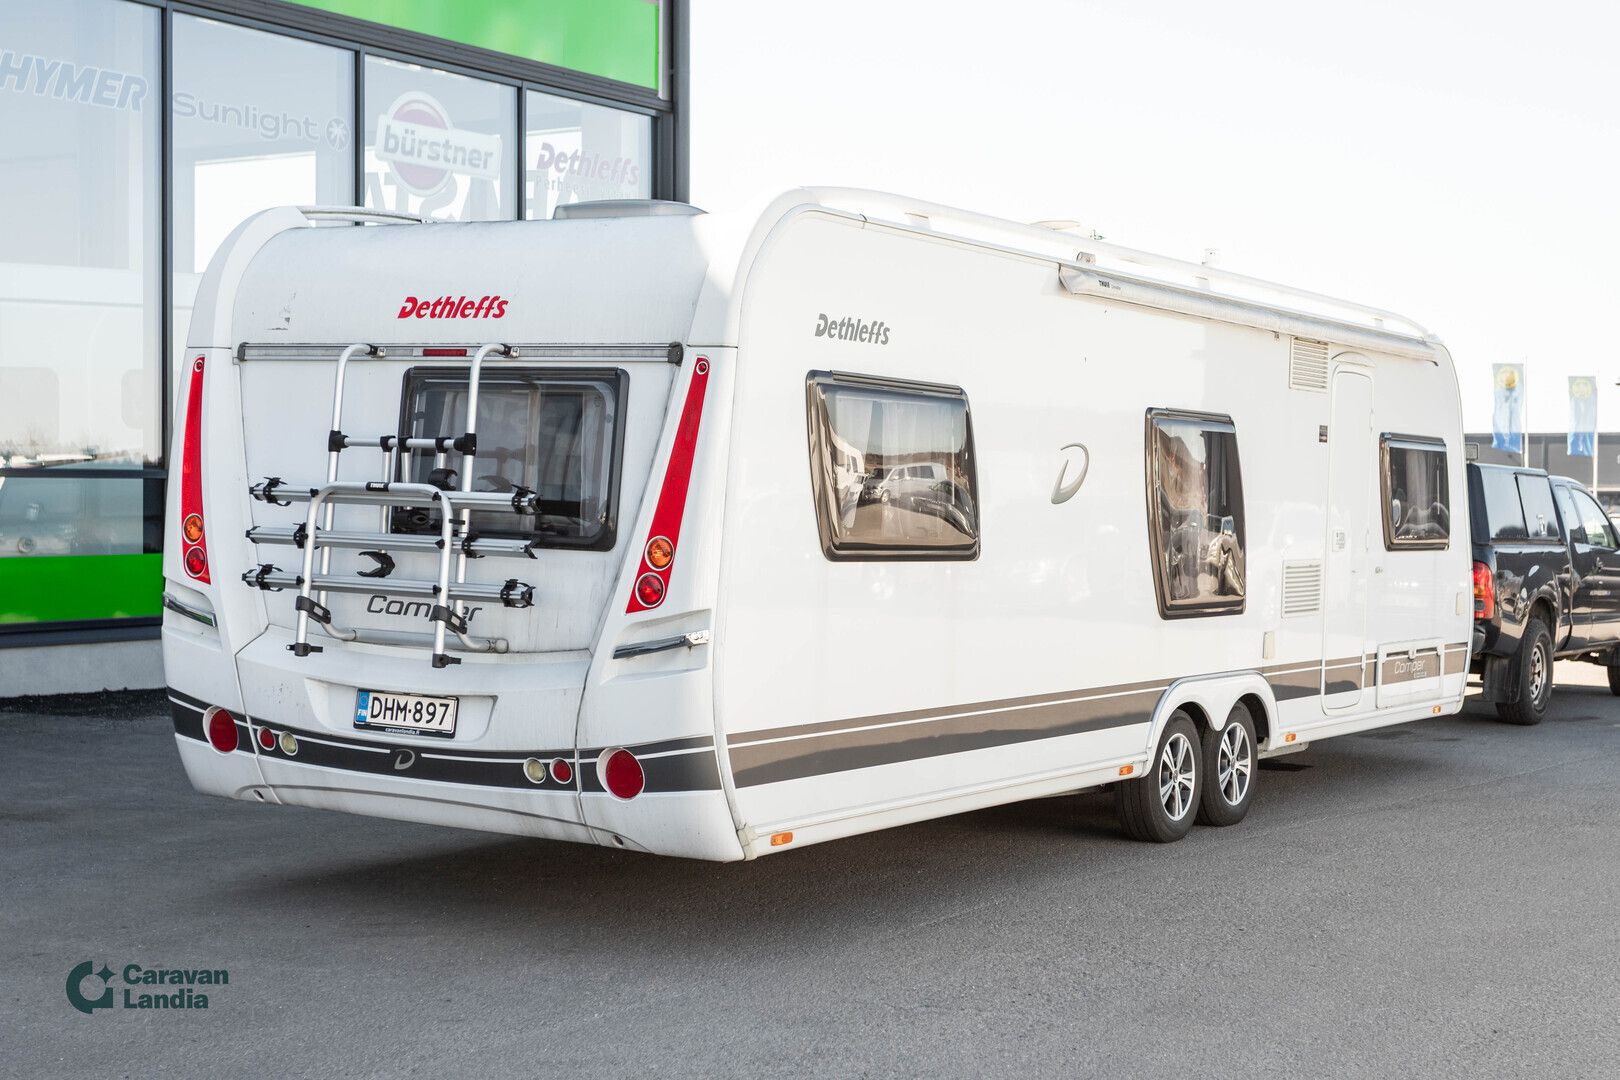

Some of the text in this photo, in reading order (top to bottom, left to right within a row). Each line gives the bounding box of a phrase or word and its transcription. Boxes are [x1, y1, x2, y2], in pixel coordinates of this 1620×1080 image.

[0, 51, 148, 112] HYMER
[173, 92, 320, 142] Sunlight
[383, 124, 494, 171] bürstner
[536, 142, 640, 187] Dethleffs
[398, 295, 508, 319] Dethleffs
[815, 313, 890, 345] Dethleffs
[370, 696, 450, 726] DHM-897
